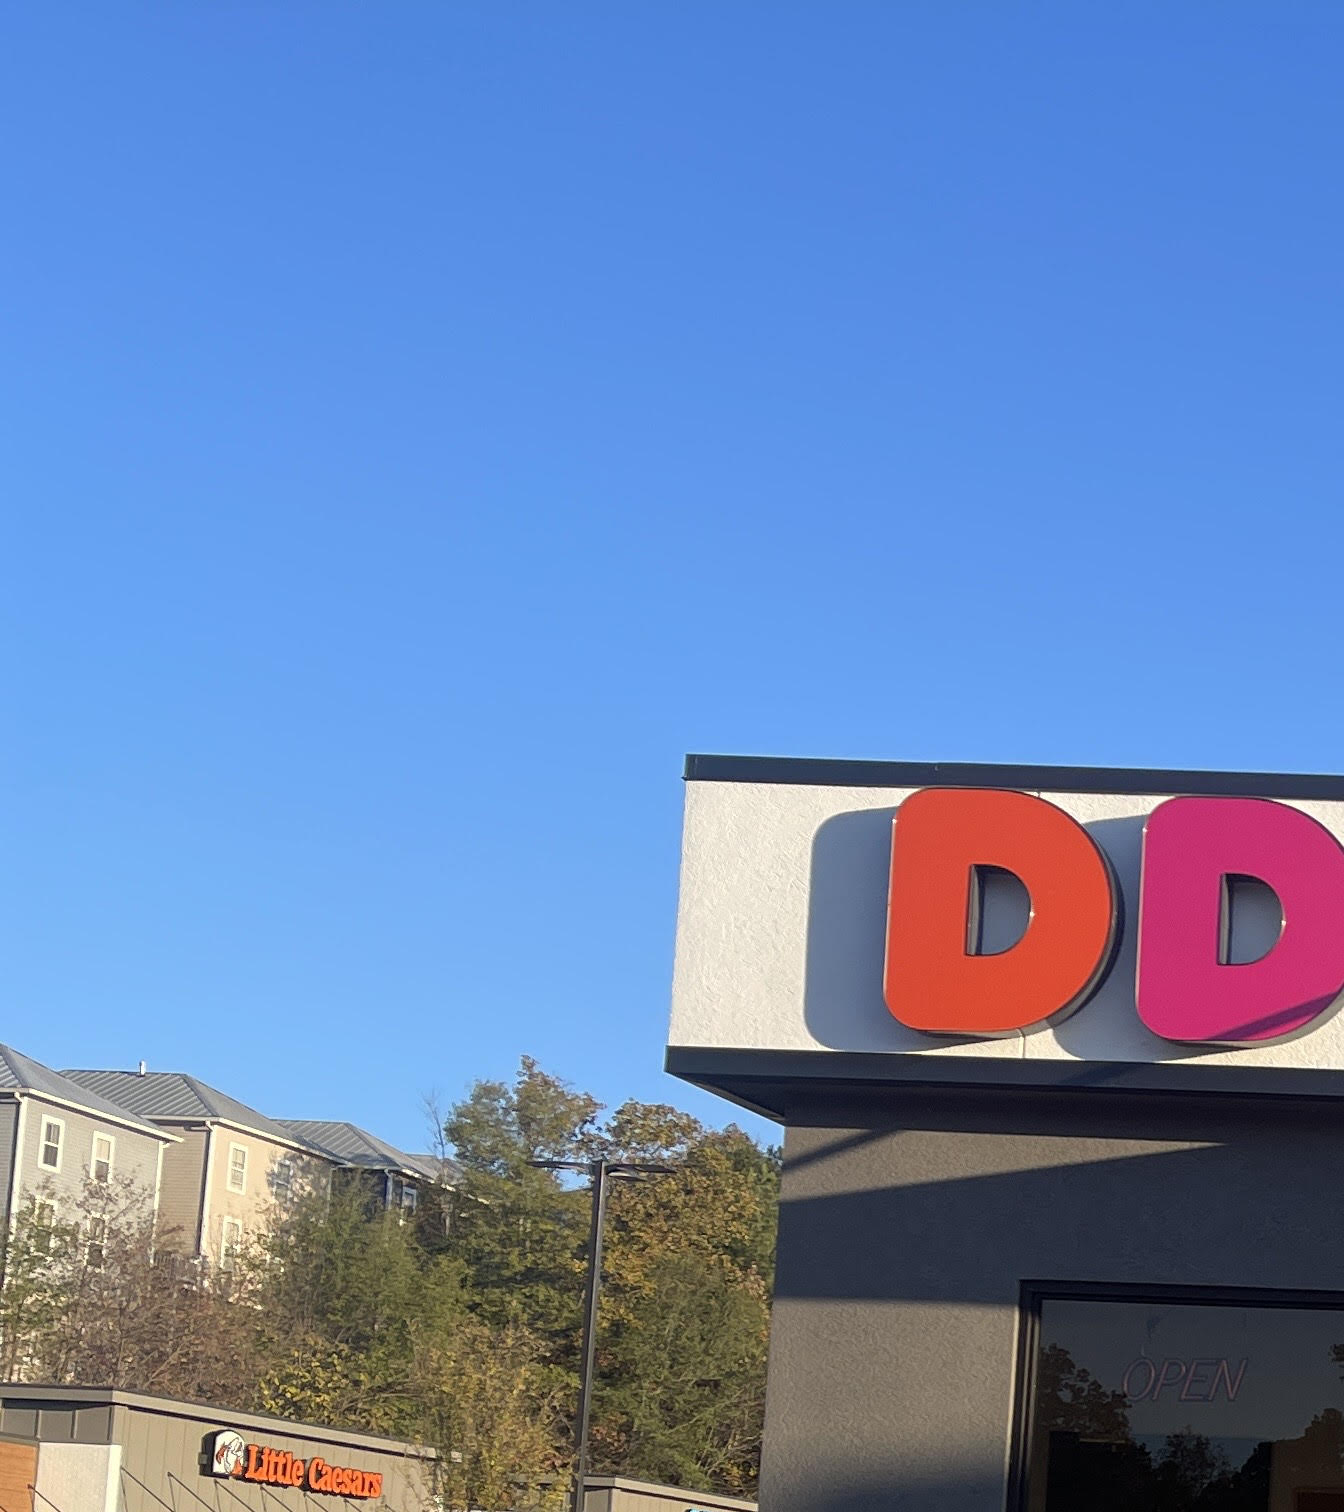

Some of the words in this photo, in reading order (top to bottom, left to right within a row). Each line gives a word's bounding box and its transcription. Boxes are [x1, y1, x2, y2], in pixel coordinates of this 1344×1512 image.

[1122, 1358, 1248, 1401] OPEN
[245, 1444, 304, 1487] Little
[308, 1457, 383, 1498] Caesars
